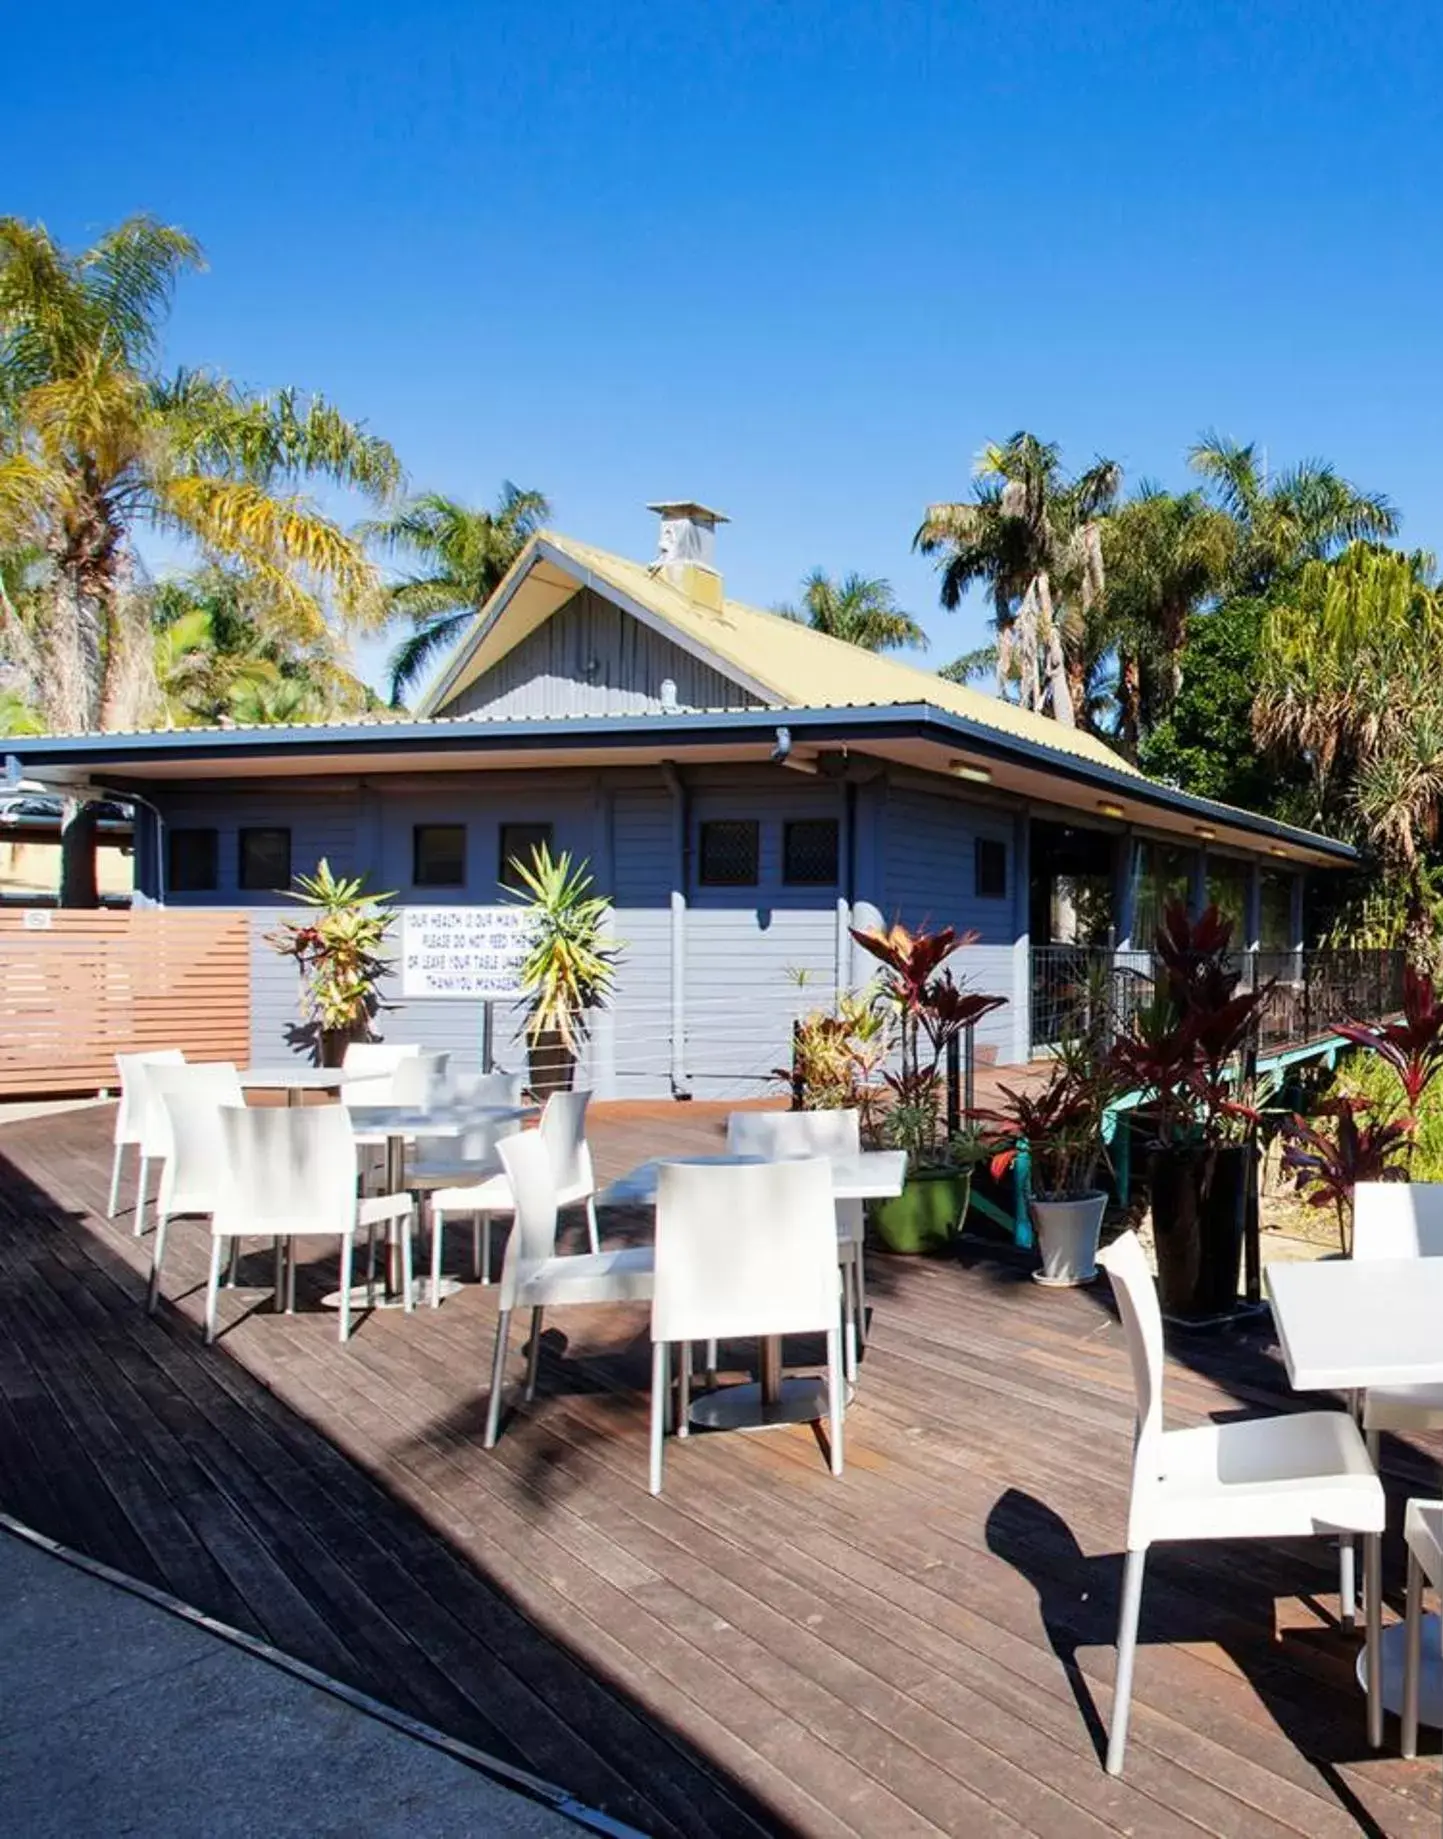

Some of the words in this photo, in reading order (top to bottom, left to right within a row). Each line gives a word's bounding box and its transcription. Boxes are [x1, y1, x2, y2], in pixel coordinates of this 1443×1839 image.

[407, 912, 427, 929] YOUR
[430, 912, 461, 929] HEALTH
[476, 912, 493, 929] OUR
[496, 912, 519, 929] MAIN
[422, 933, 451, 949] PLEASE
[453, 933, 466, 949] DO
[468, 933, 486, 949] NOT
[489, 933, 509, 949] FEED
[407, 954, 419, 970] OR
[422, 954, 446, 970] LEAVE
[448, 954, 471, 970] YOUR
[474, 954, 499, 970] TABLE
